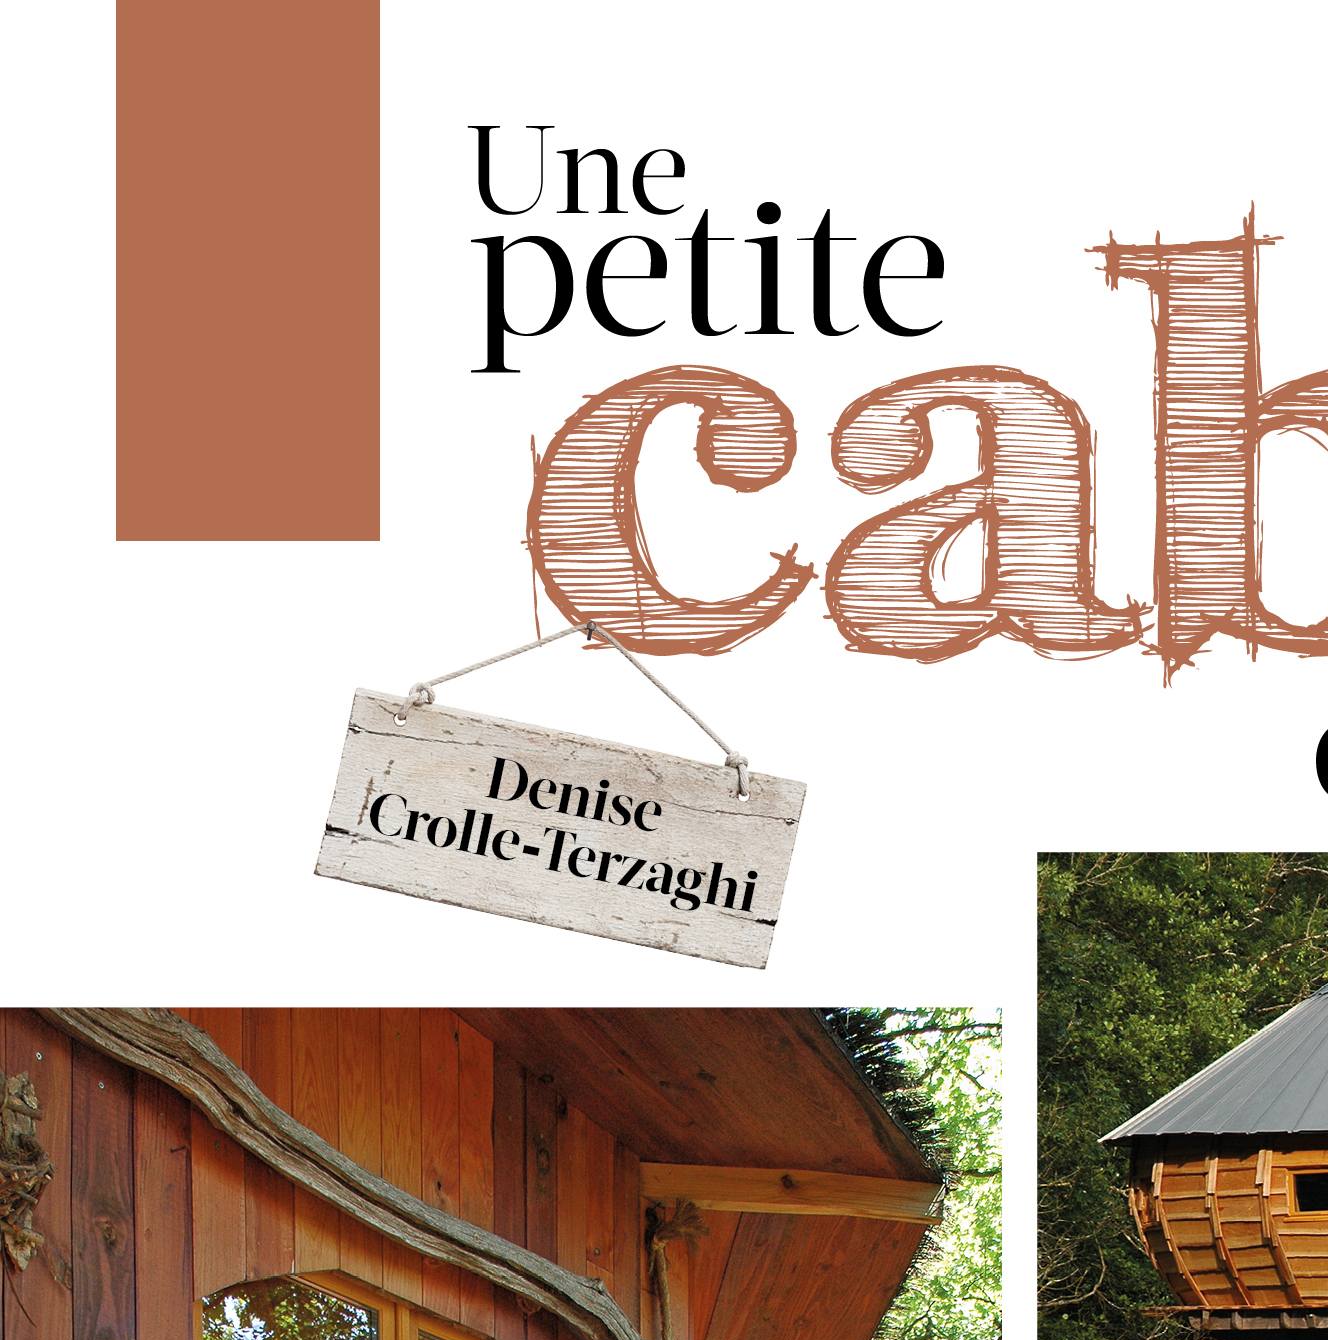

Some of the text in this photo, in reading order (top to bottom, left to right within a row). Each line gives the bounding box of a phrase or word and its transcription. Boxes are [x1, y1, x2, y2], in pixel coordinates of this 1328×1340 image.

[467, 125, 686, 215] Une
[470, 201, 945, 374] petite
[486, 756, 662, 831] Denise
[369, 793, 758, 912] Crolle-Terzaghi
